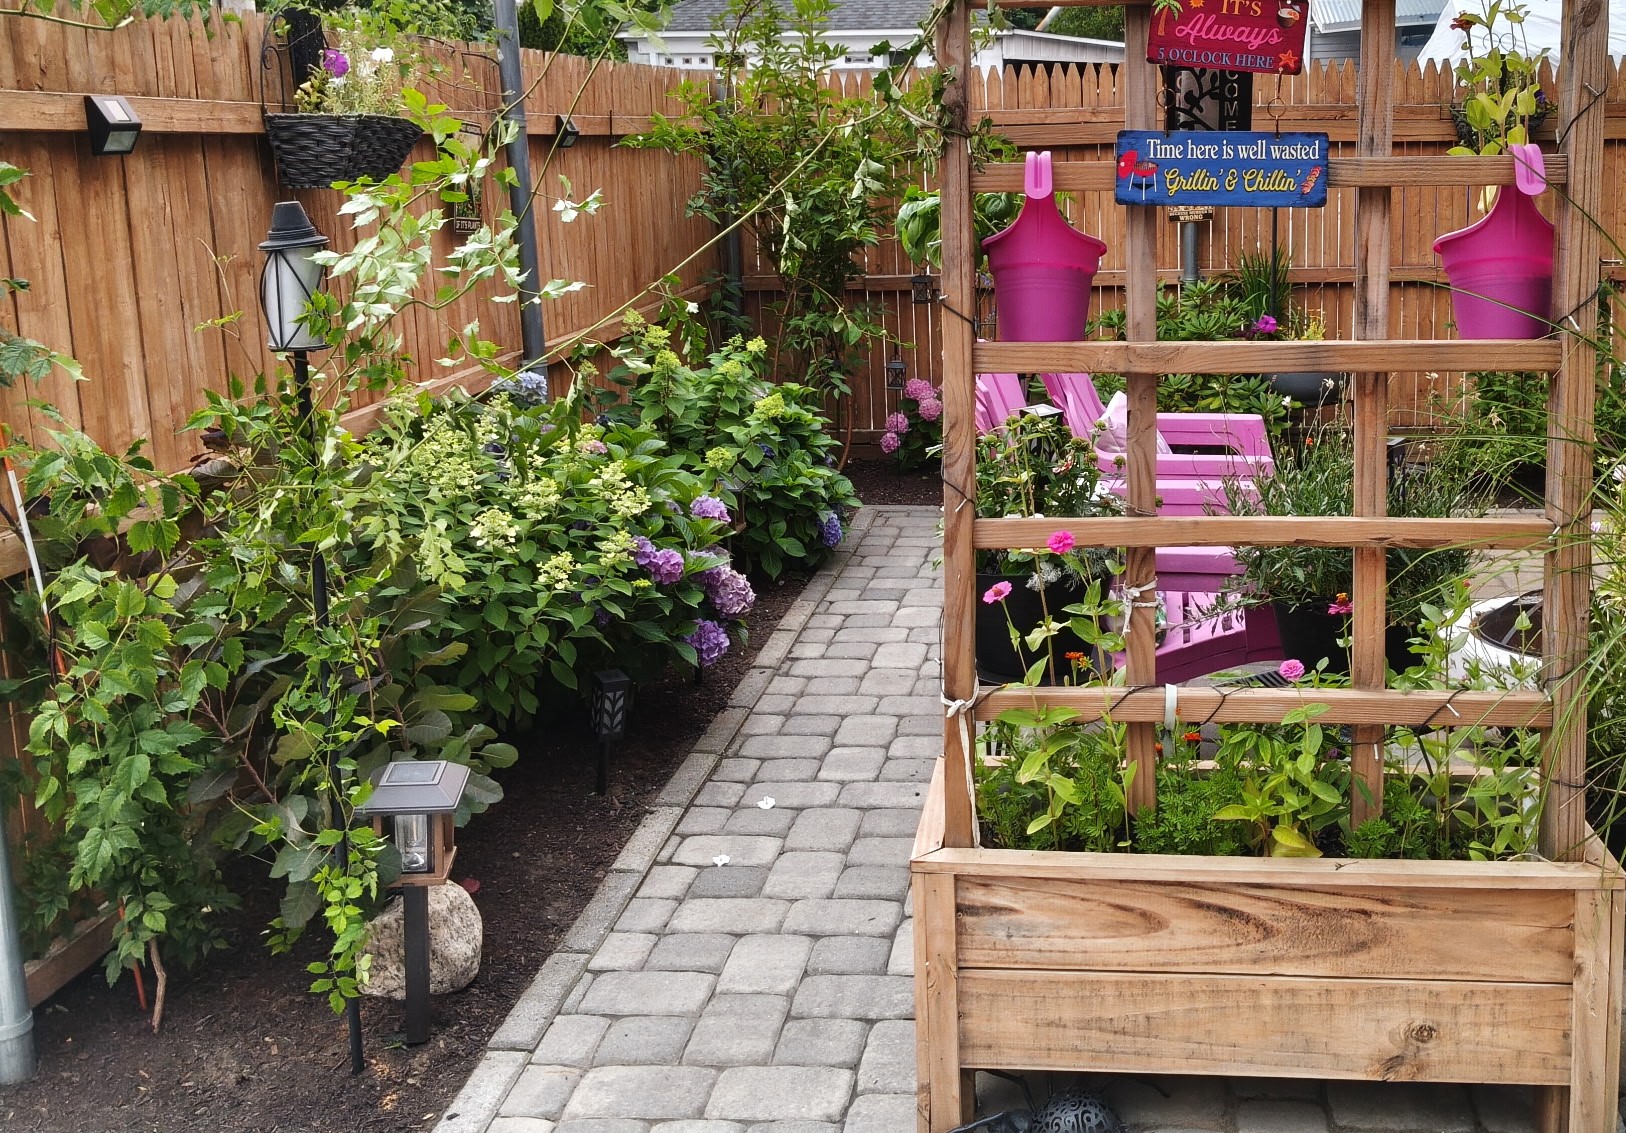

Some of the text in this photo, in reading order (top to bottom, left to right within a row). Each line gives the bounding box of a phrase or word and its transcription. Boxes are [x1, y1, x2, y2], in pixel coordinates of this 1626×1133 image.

[1220, 0, 1262, 16] IT'S
[1175, 13, 1283, 50] Always
[1157, 47, 1275, 69] 5 O'CLOCK HERE
[1146, 138, 1320, 160] Time here is well wasted
[1164, 168, 1301, 196] Grillin' & Chillin'
